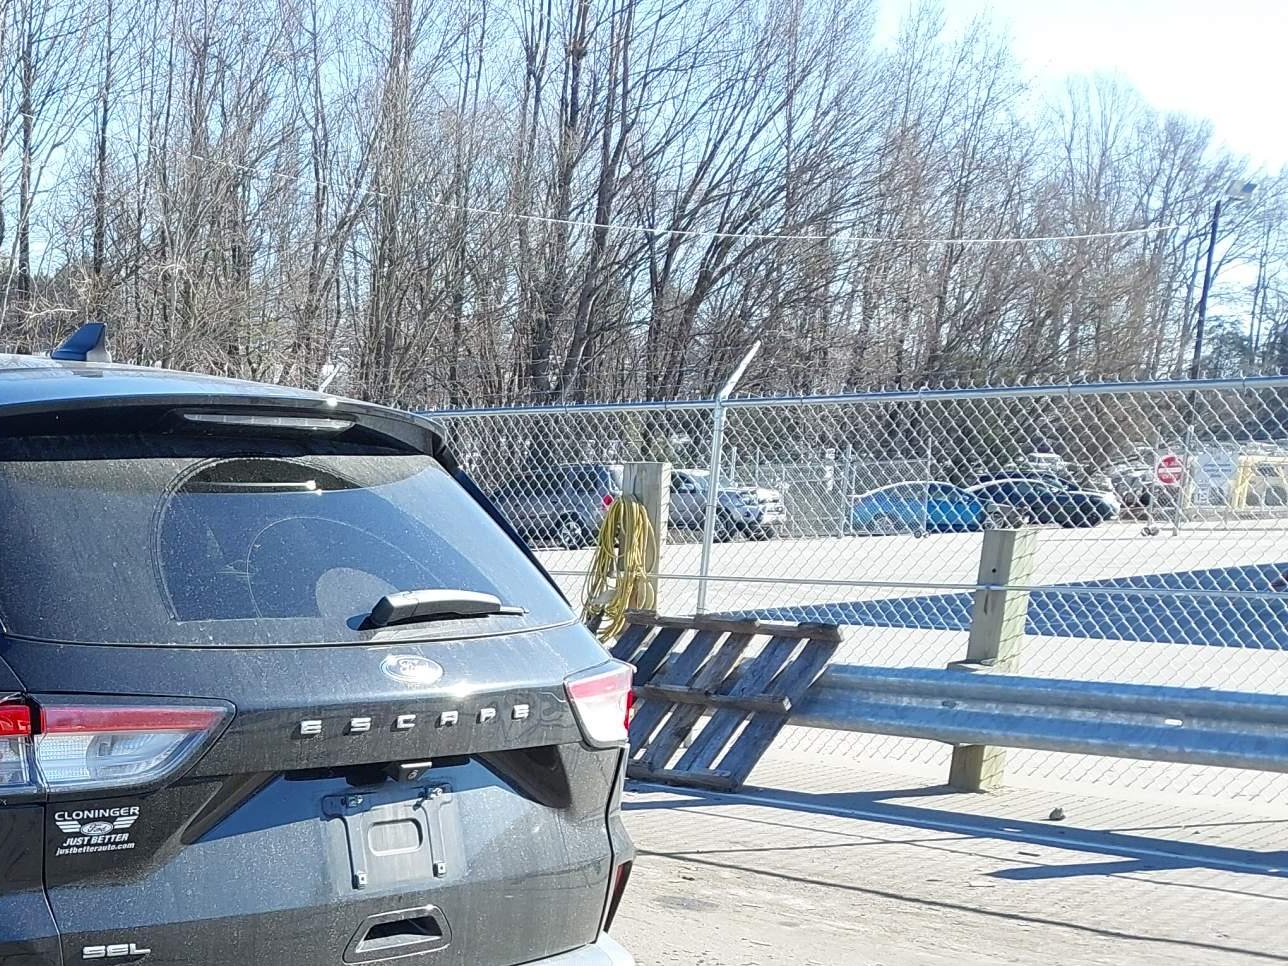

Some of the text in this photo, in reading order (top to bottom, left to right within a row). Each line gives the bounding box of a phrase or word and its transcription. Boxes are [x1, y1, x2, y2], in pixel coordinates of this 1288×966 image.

[300, 703, 530, 735] ESCAPE
[54, 806, 140, 821] CLONINGER
[62, 833, 130, 847] JUST BETTER
[55, 842, 136, 857] justbetterauto.com
[82, 943, 151, 959] SEL
